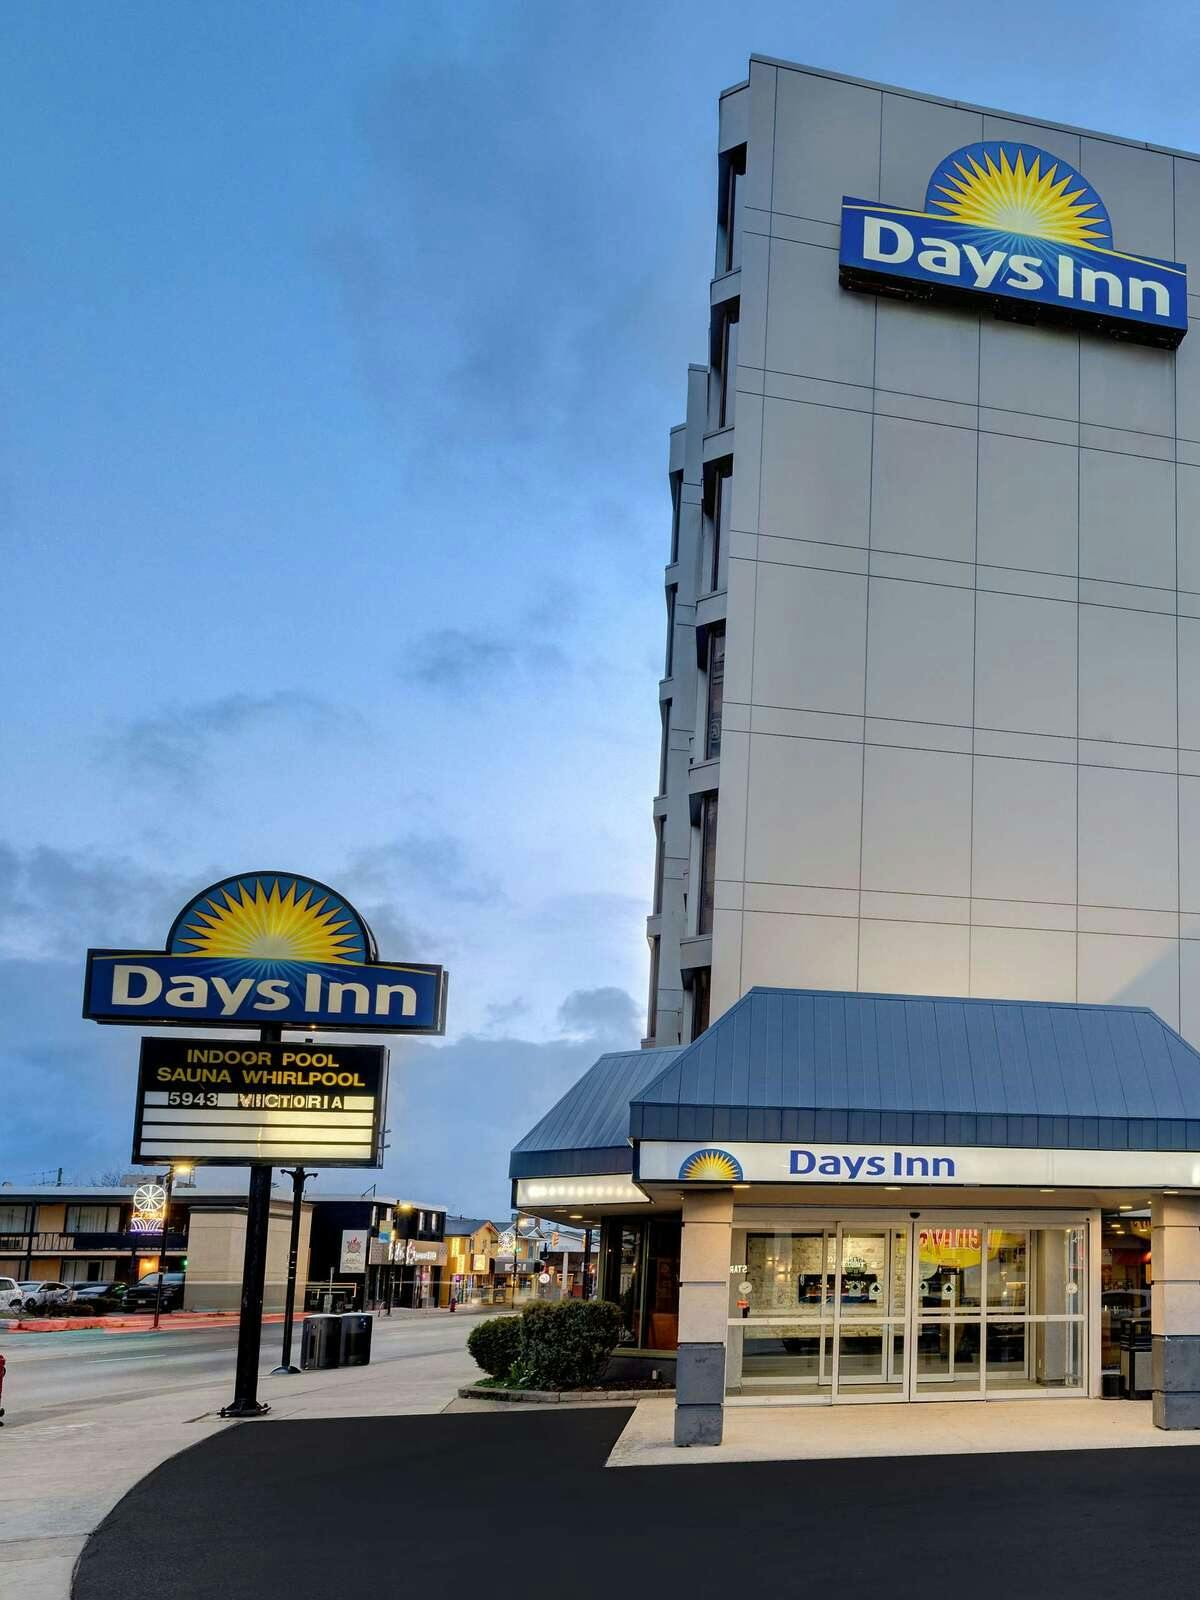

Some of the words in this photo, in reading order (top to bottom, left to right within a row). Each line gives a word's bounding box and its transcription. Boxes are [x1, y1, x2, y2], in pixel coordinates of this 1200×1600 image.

[862, 215, 1044, 290] Days
[1057, 253, 1170, 318] Inn
[111, 964, 291, 1016] Days
[304, 973, 417, 1017] Inn
[187, 1049, 272, 1066] INDOOR
[282, 1053, 340, 1068] POOL
[156, 1067, 232, 1084] SAUNA
[242, 1070, 366, 1087] WHIRLPOOL
[168, 1091, 218, 1107] 5943
[239, 1093, 343, 1110] VICTORIA
[789, 1149, 886, 1180] Days
[893, 1152, 955, 1177] Inn
